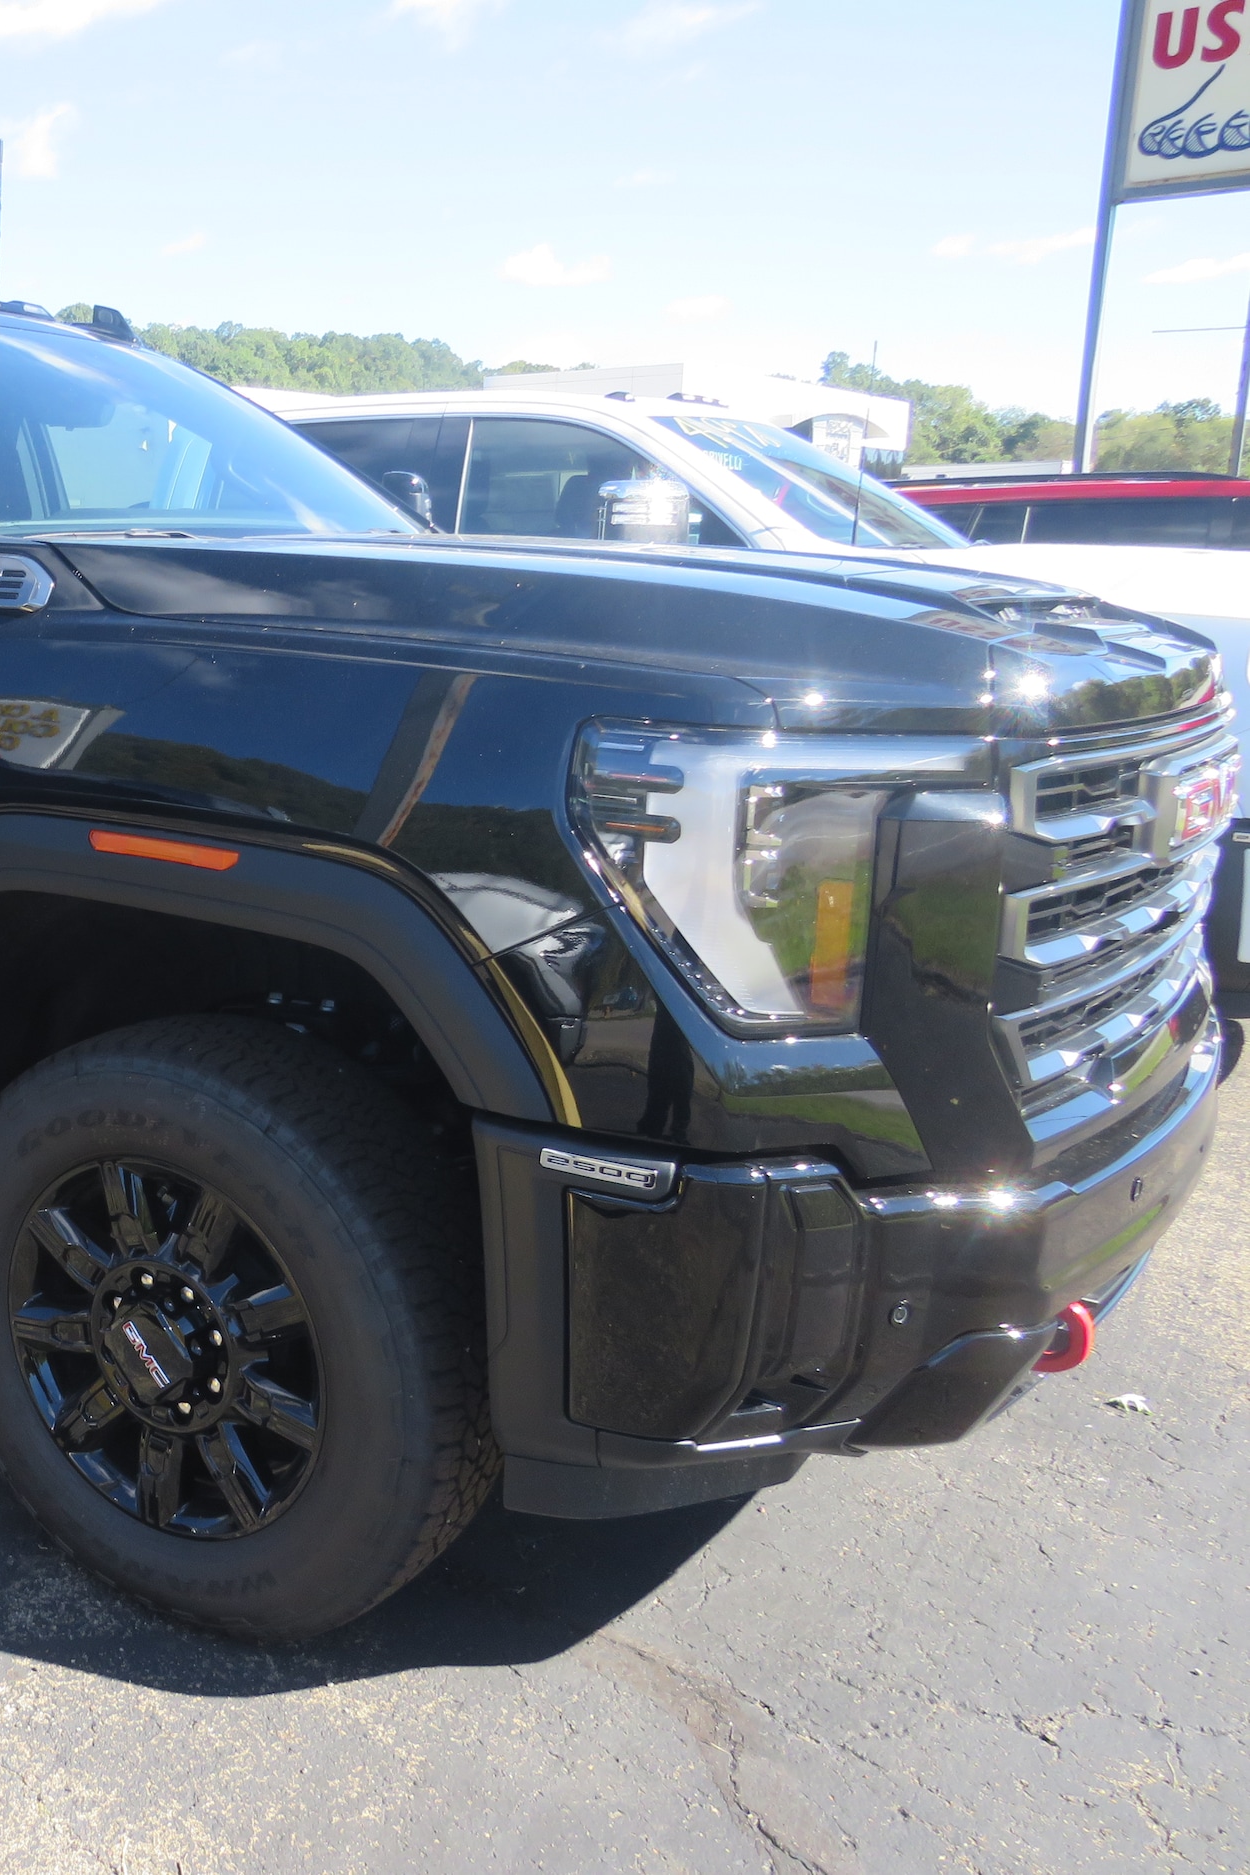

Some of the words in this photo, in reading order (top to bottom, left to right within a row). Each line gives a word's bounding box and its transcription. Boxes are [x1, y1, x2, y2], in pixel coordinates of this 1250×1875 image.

[1152, 0, 1246, 70] US
[547, 1154, 655, 1188] 2500
[121, 1320, 171, 1389] GMC
